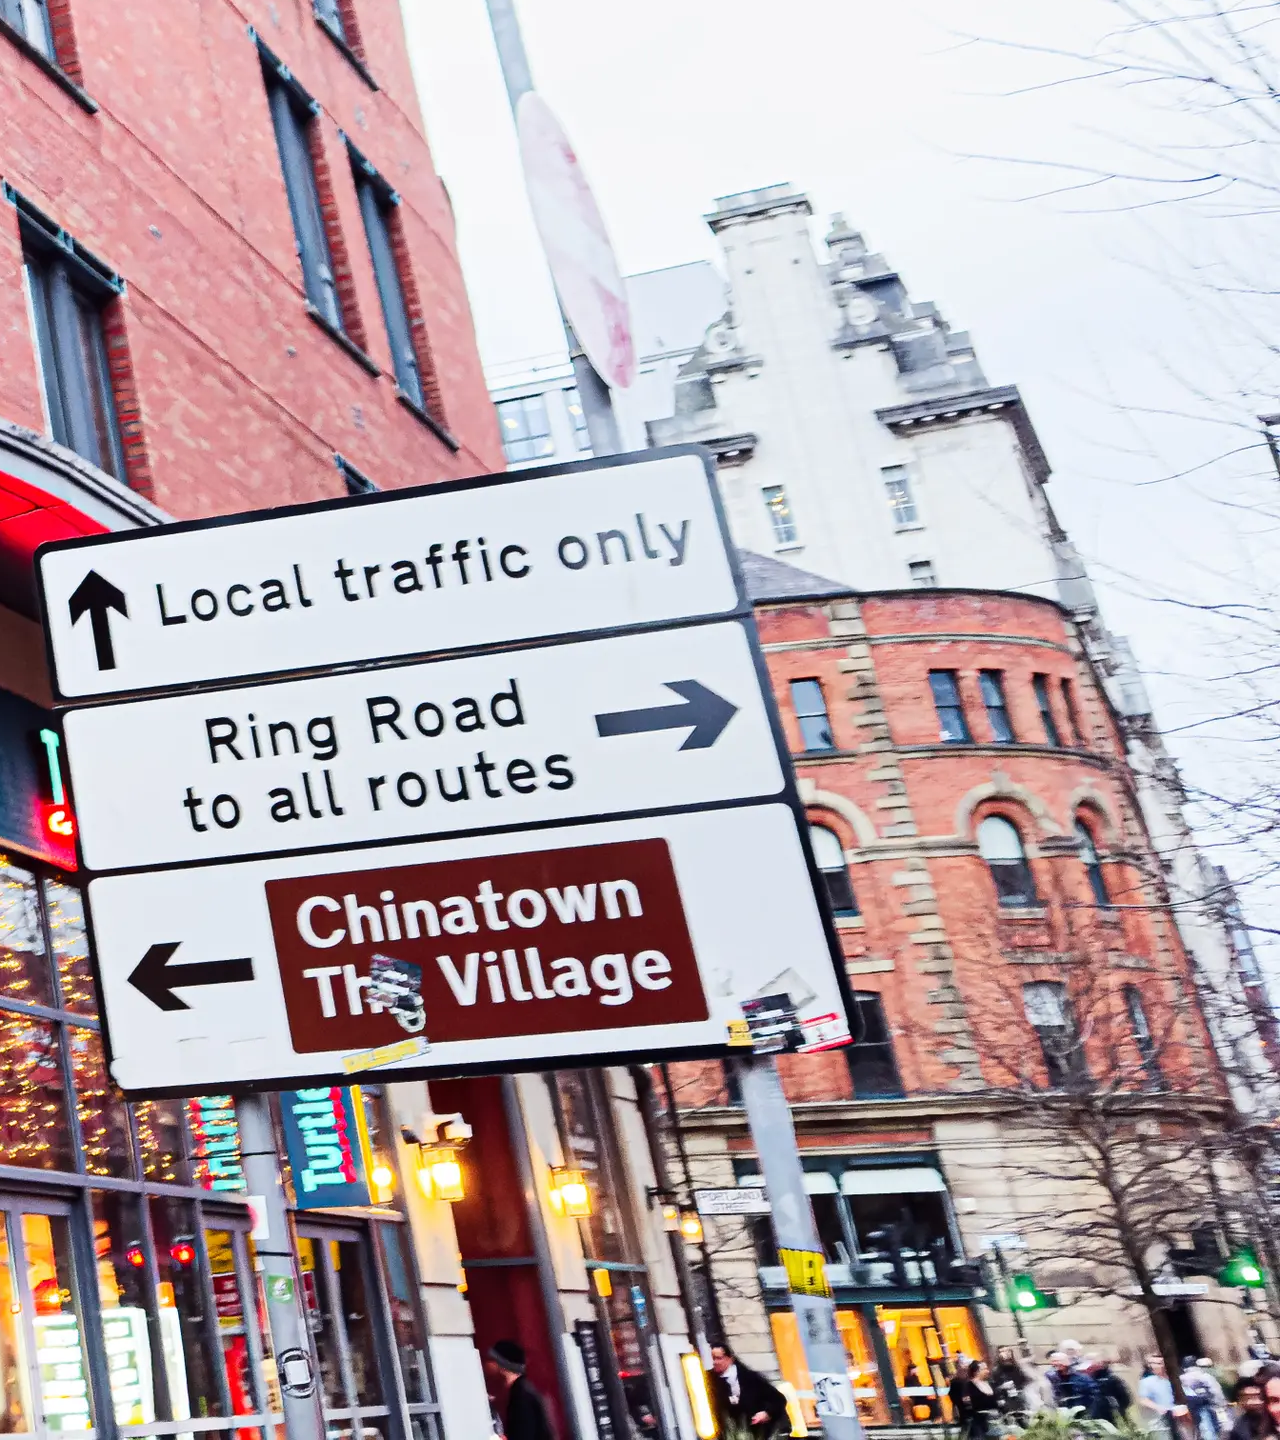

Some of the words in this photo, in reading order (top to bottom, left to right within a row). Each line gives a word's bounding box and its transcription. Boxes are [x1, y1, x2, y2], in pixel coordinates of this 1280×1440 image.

[156, 563, 313, 626] Local
[334, 536, 532, 603] traffic
[557, 512, 692, 570] only
[205, 712, 340, 763] Ring
[366, 677, 526, 744] Road
[183, 786, 242, 832] to
[268, 768, 345, 823] all
[367, 750, 578, 811] routes
[295, 879, 644, 949] Chinatown
[302, 963, 423, 1018] Th
[436, 946, 673, 1006] Village
